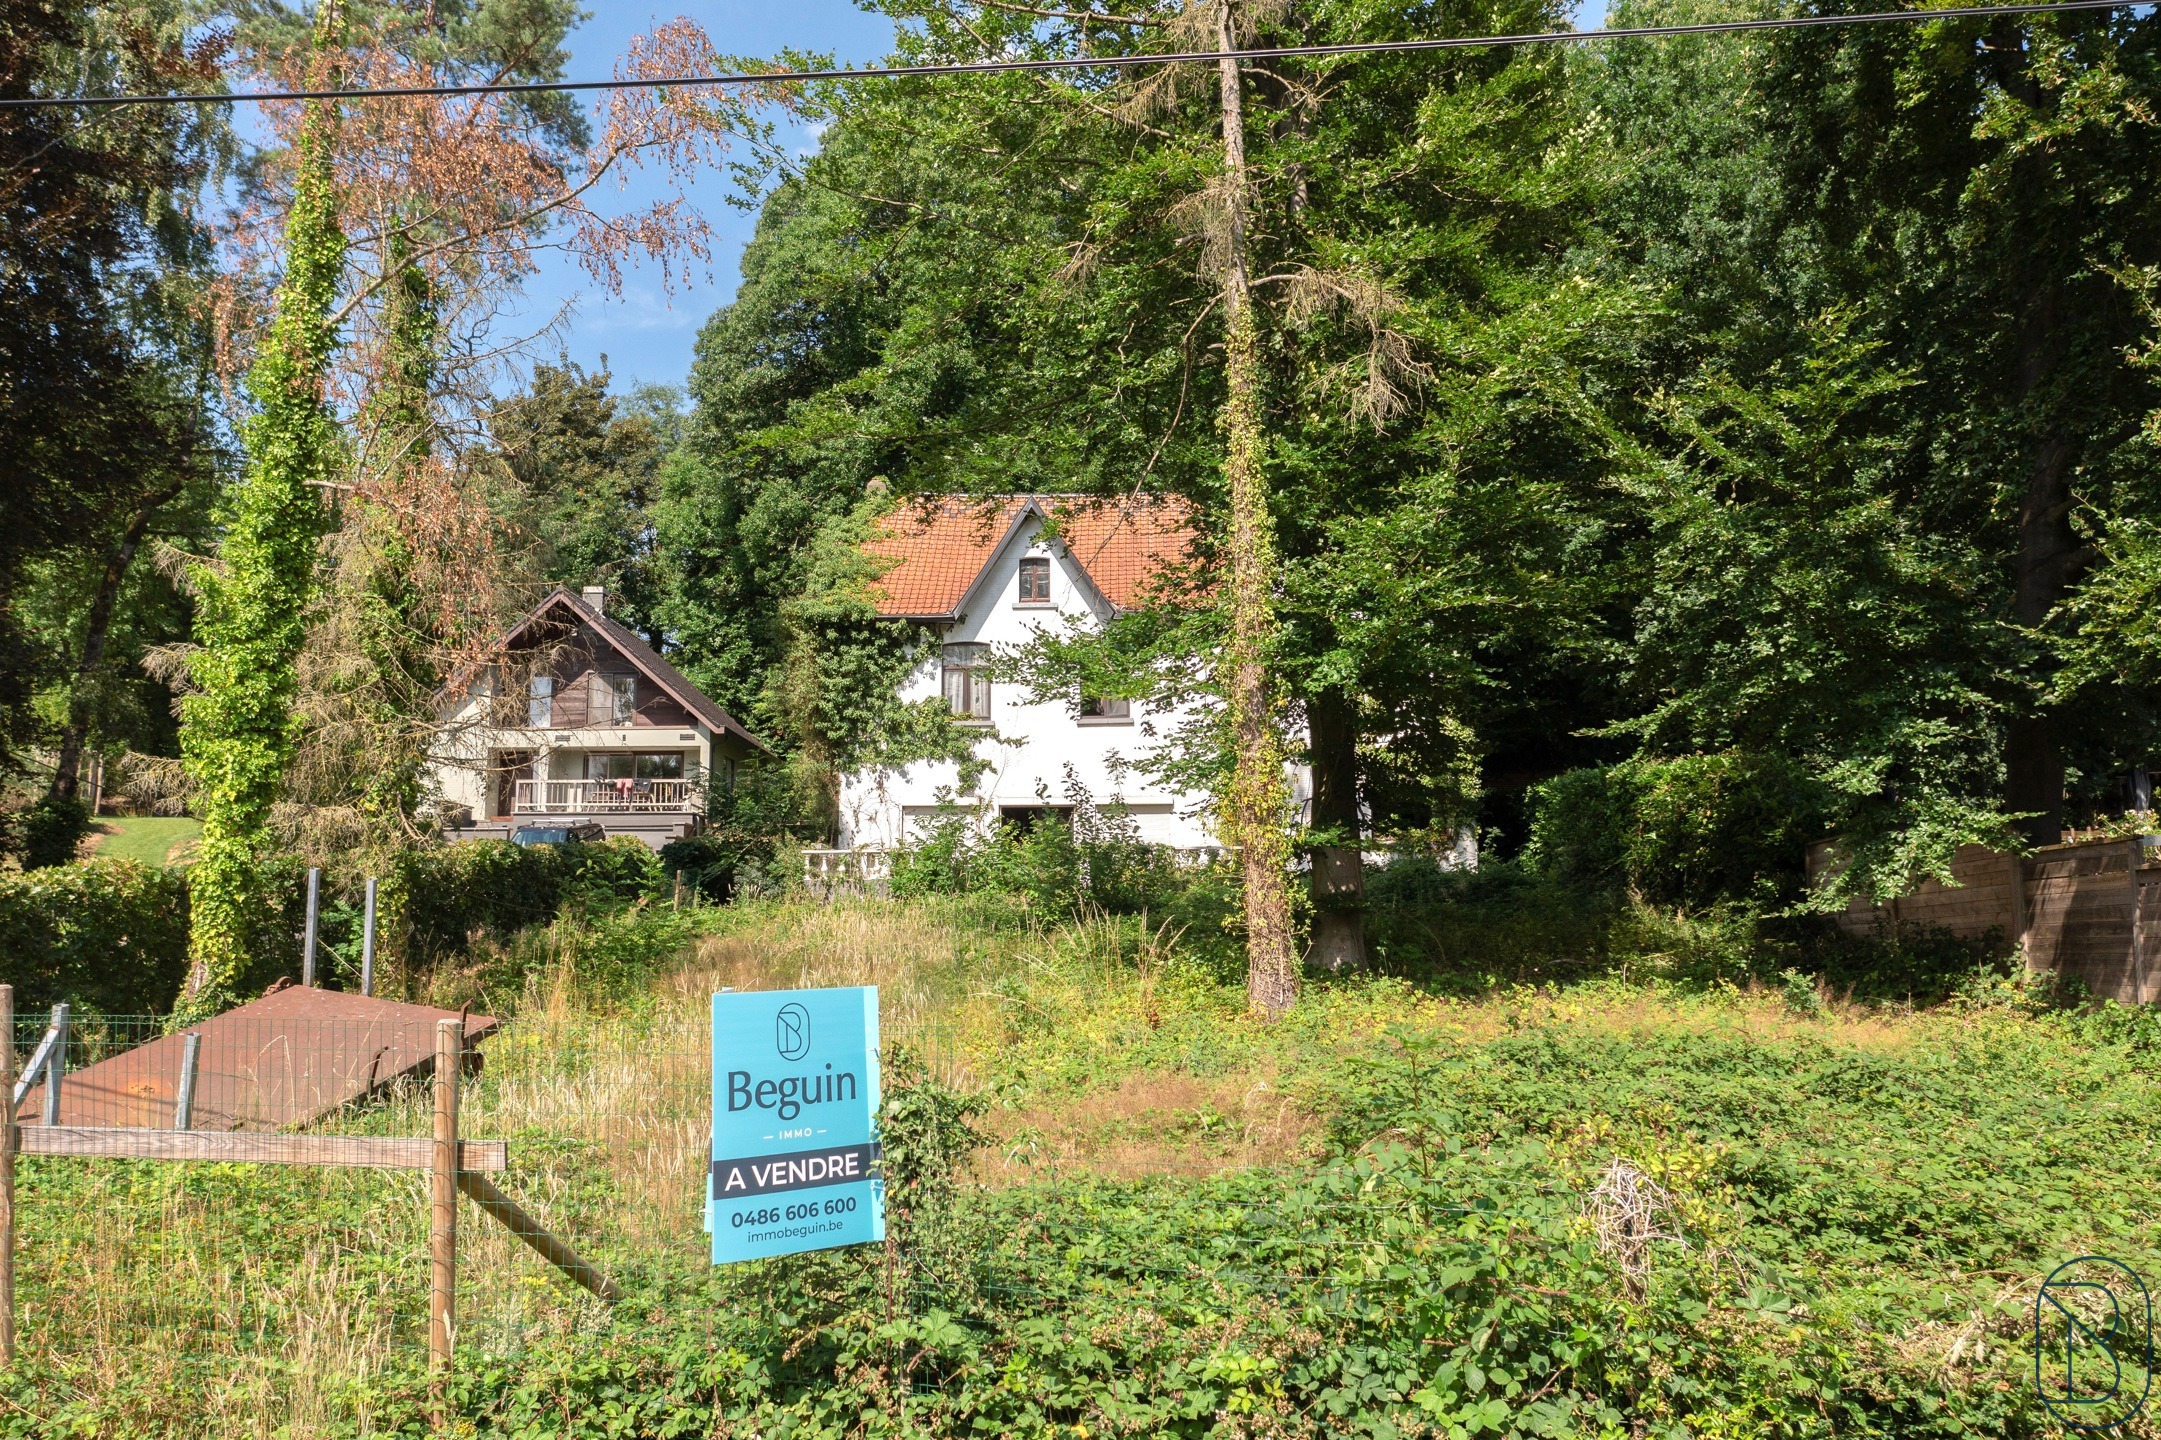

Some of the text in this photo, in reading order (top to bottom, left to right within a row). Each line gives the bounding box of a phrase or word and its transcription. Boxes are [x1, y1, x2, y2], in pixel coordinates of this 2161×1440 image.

[727, 1063, 856, 1120] Beguin
[779, 1127, 812, 1140] IMMO
[724, 1153, 859, 1192] A VENDRE
[731, 1197, 857, 1228] 0486 606 600
[747, 1220, 843, 1243] immobeguin.be
